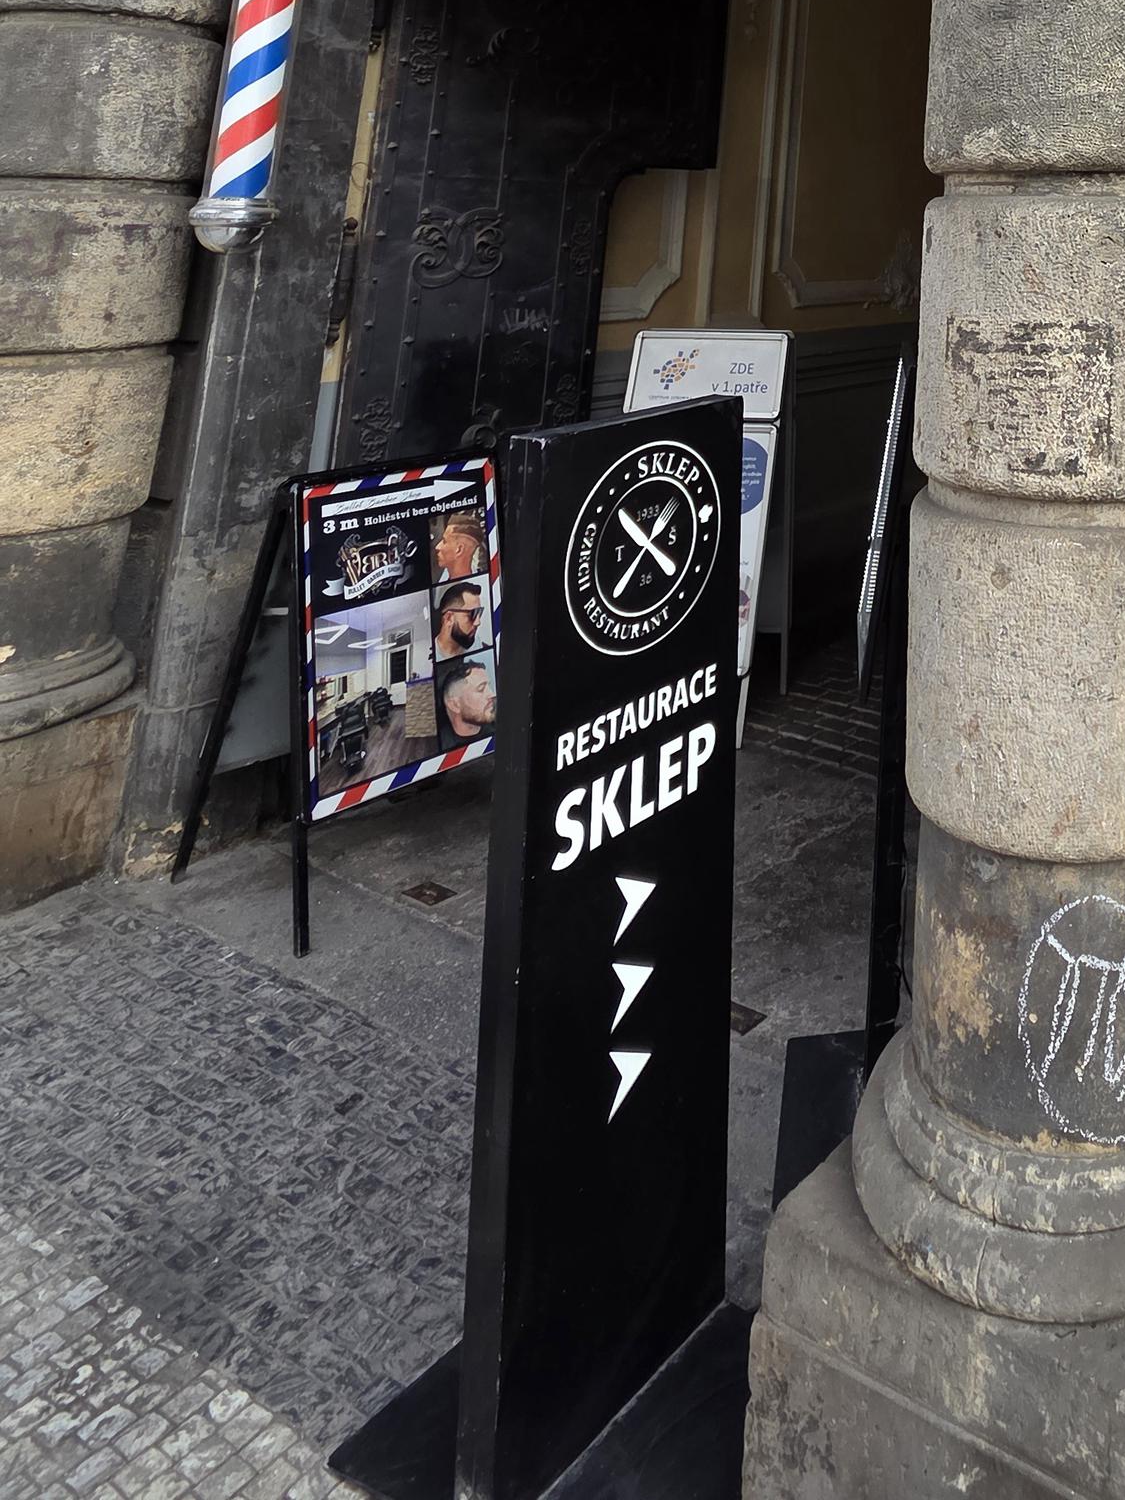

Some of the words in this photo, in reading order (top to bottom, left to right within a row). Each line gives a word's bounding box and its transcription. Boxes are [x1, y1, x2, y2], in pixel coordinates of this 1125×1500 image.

[712, 382, 719, 393] v
[729, 362, 754, 375] ZDE
[637, 451, 700, 487] SKLEP
[323, 519, 336, 535] 3
[339, 517, 359, 532] m
[364, 508, 411, 527] Holičství
[412, 506, 429, 518] bez
[431, 495, 478, 515] objednání
[577, 522, 597, 592] CZECH
[583, 596, 670, 641] RESTAURANT
[556, 663, 718, 772] RESTAURACE
[551, 722, 717, 872] SKLEP
